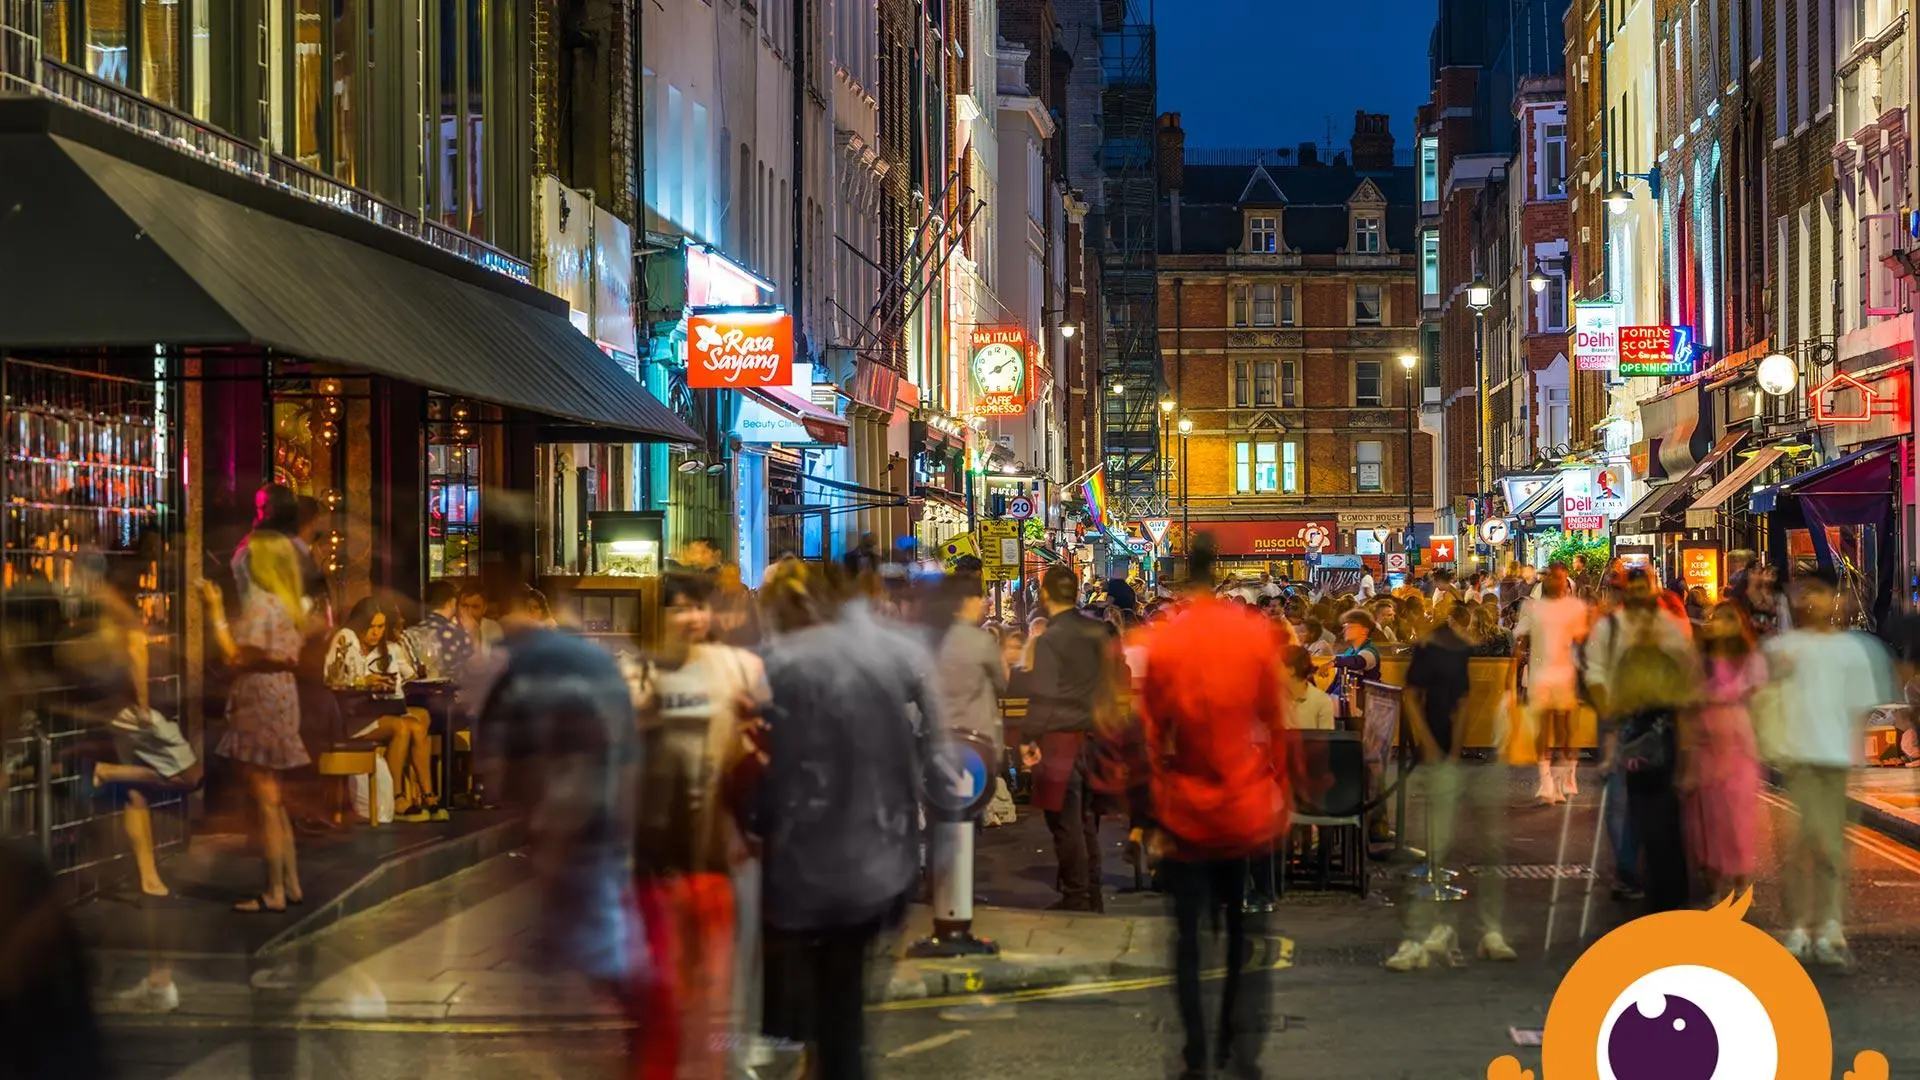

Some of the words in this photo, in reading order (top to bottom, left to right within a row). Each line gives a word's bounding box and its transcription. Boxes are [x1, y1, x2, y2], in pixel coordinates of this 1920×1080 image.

[973, 333, 990, 344] BAR
[993, 332, 1023, 343] ITALIA
[1621, 327, 1671, 339] ronnie
[722, 328, 774, 355] Rasa
[1578, 332, 1614, 347] Delhi
[703, 349, 780, 382] Sayang
[975, 404, 1023, 414] ESPRESSO
[743, 419, 776, 430] Beauty
[1012, 502, 1029, 513] 20
[1567, 516, 1600, 524] INDIAN
[1691, 561, 1710, 569] KEEP
